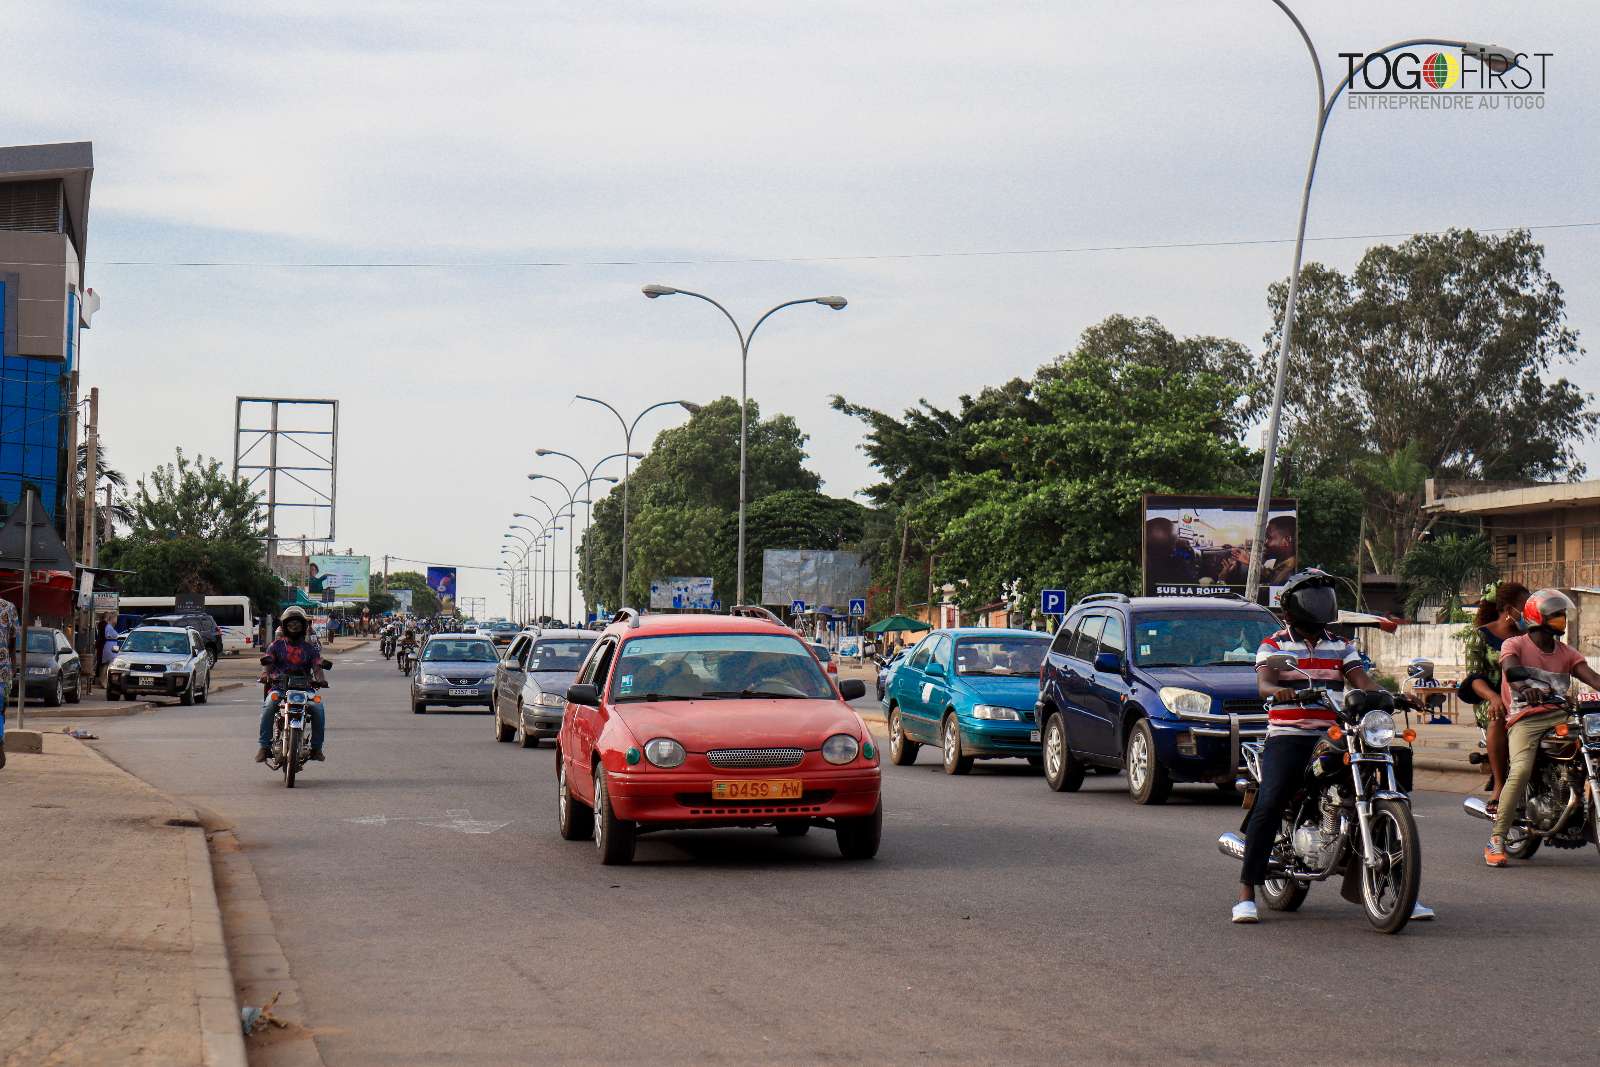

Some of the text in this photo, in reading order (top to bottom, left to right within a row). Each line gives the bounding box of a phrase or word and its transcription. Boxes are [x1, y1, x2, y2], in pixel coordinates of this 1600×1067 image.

[1156, 586, 1231, 595] SUR LA ROUTE
[1047, 594, 1059, 609] P
[729, 782, 769, 797] 0459
